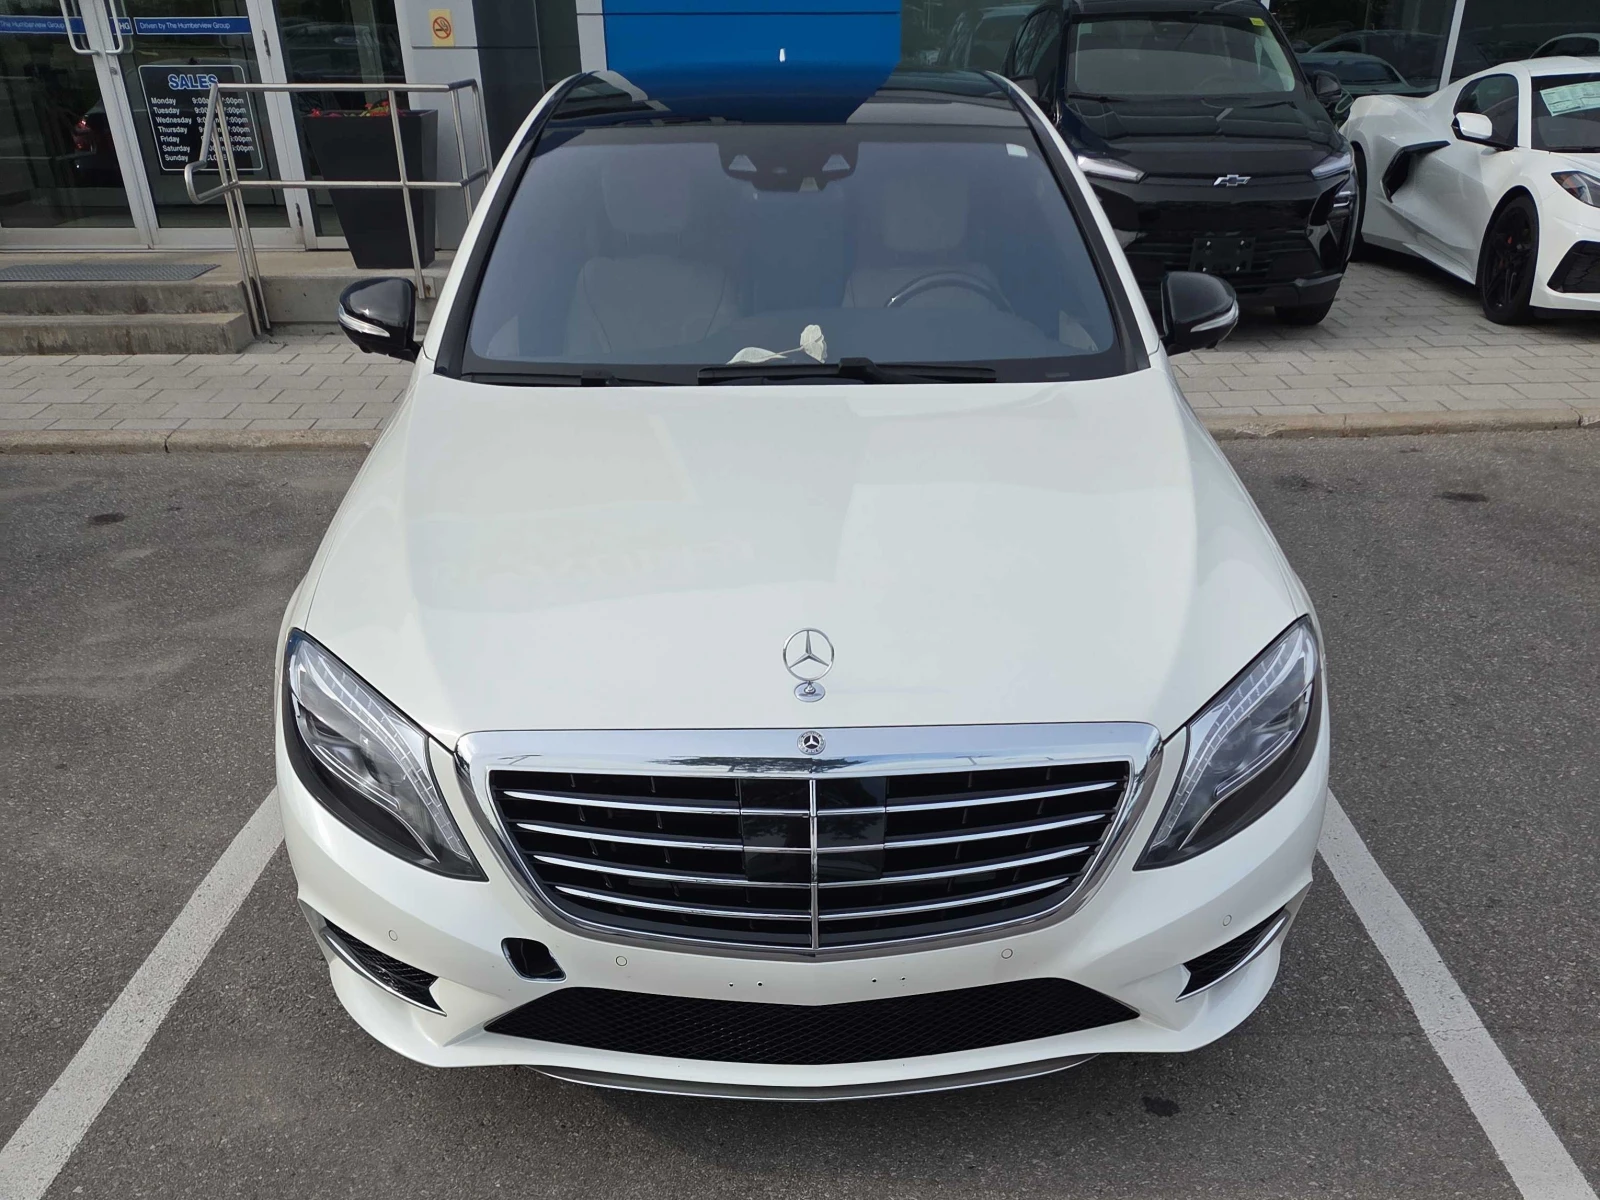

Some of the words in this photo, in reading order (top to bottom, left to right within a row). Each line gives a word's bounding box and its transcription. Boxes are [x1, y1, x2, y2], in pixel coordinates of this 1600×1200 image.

[158, 22, 165, 30] by
[212, 22, 231, 30] Group
[168, 74, 218, 90] SALES
[151, 97, 176, 106] Monday
[154, 107, 180, 115] Tuesday
[156, 117, 192, 125] Wednesday
[158, 126, 188, 134] Thursday
[161, 135, 180, 144] Friday
[163, 145, 190, 153] Saturday
[165, 154, 189, 162] Sunday
